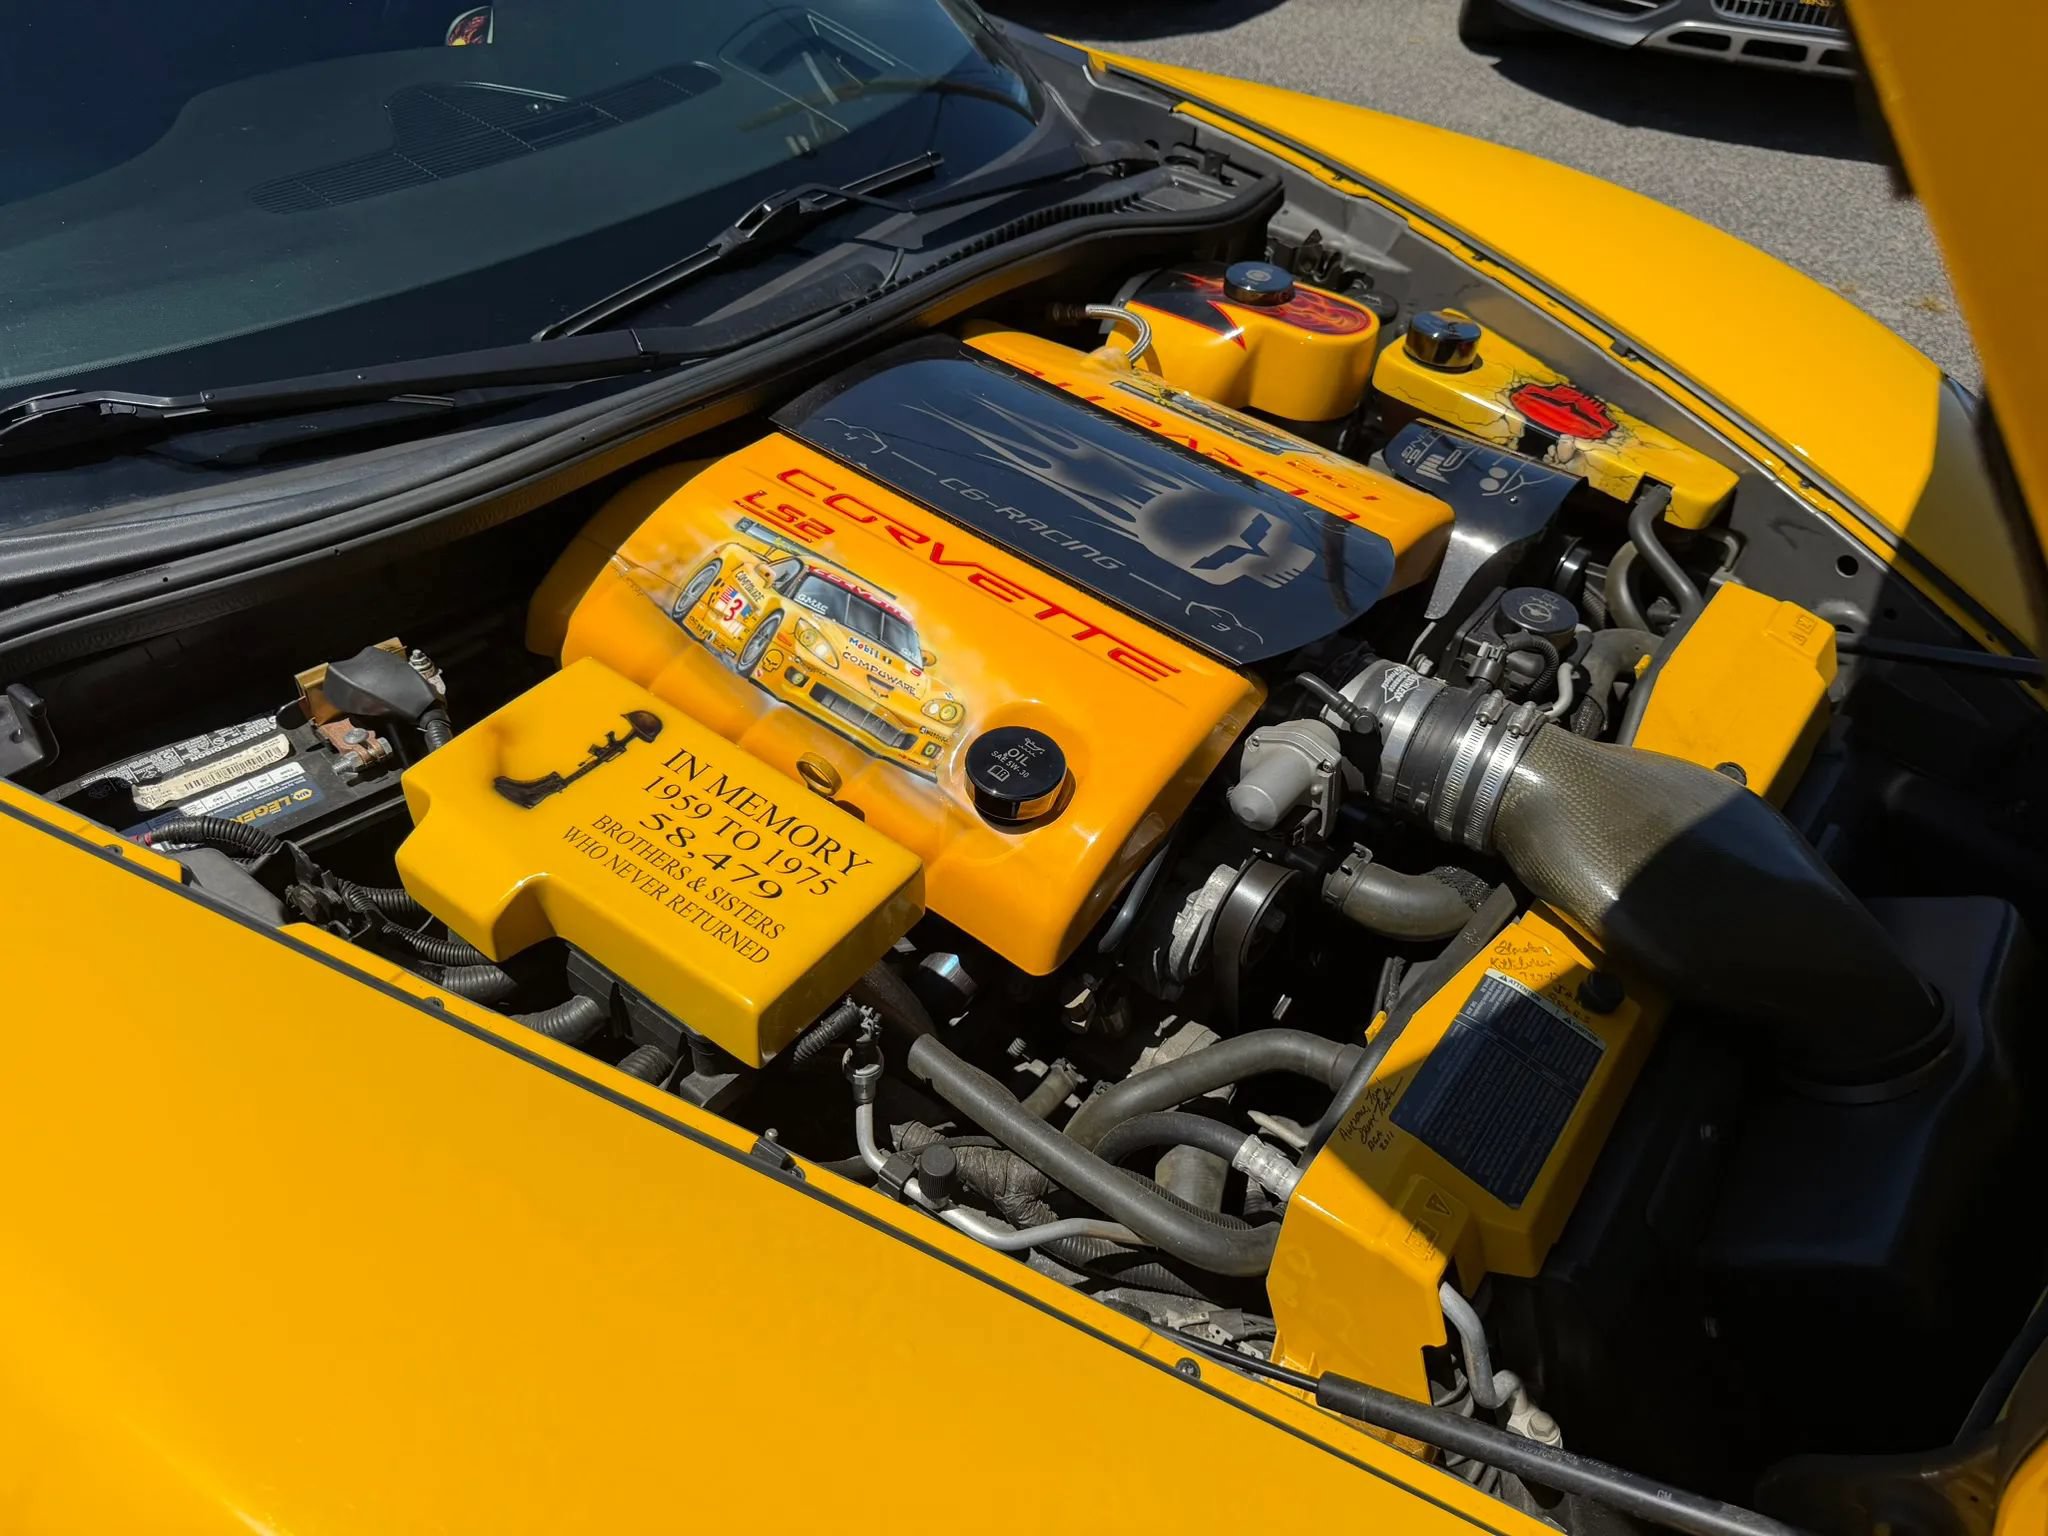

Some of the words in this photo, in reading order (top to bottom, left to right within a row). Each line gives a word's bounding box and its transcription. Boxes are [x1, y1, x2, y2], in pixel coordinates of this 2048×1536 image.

[736, 490, 836, 541] LS2
[938, 476, 1127, 571] C6-RACING
[776, 468, 1182, 682] CORVETTE
[723, 598, 743, 622] 3
[797, 592, 829, 613] GMAC
[849, 637, 879, 659] Mobil
[842, 651, 917, 694] COMPUWARE
[991, 751, 1008, 763] SAE
[1006, 760, 1030, 778] 5W-30
[1008, 748, 1029, 767] OIL
[642, 775, 713, 820] 1959
[713, 816, 761, 851] TO
[762, 849, 838, 896] 1975
[661, 747, 712, 783] IN
[704, 773, 873, 877] MEMORY
[592, 815, 692, 881] BROTHERS
[687, 876, 706, 893] &
[705, 887, 786, 940] SISTERS
[639, 813, 783, 900] 58,479
[562, 826, 608, 860] WHO
[604, 854, 670, 901] NEVER
[665, 894, 770, 964] RETURNED
[1509, 979, 1541, 1000] ATTENTION
[1656, 1489, 1673, 1500] GM
